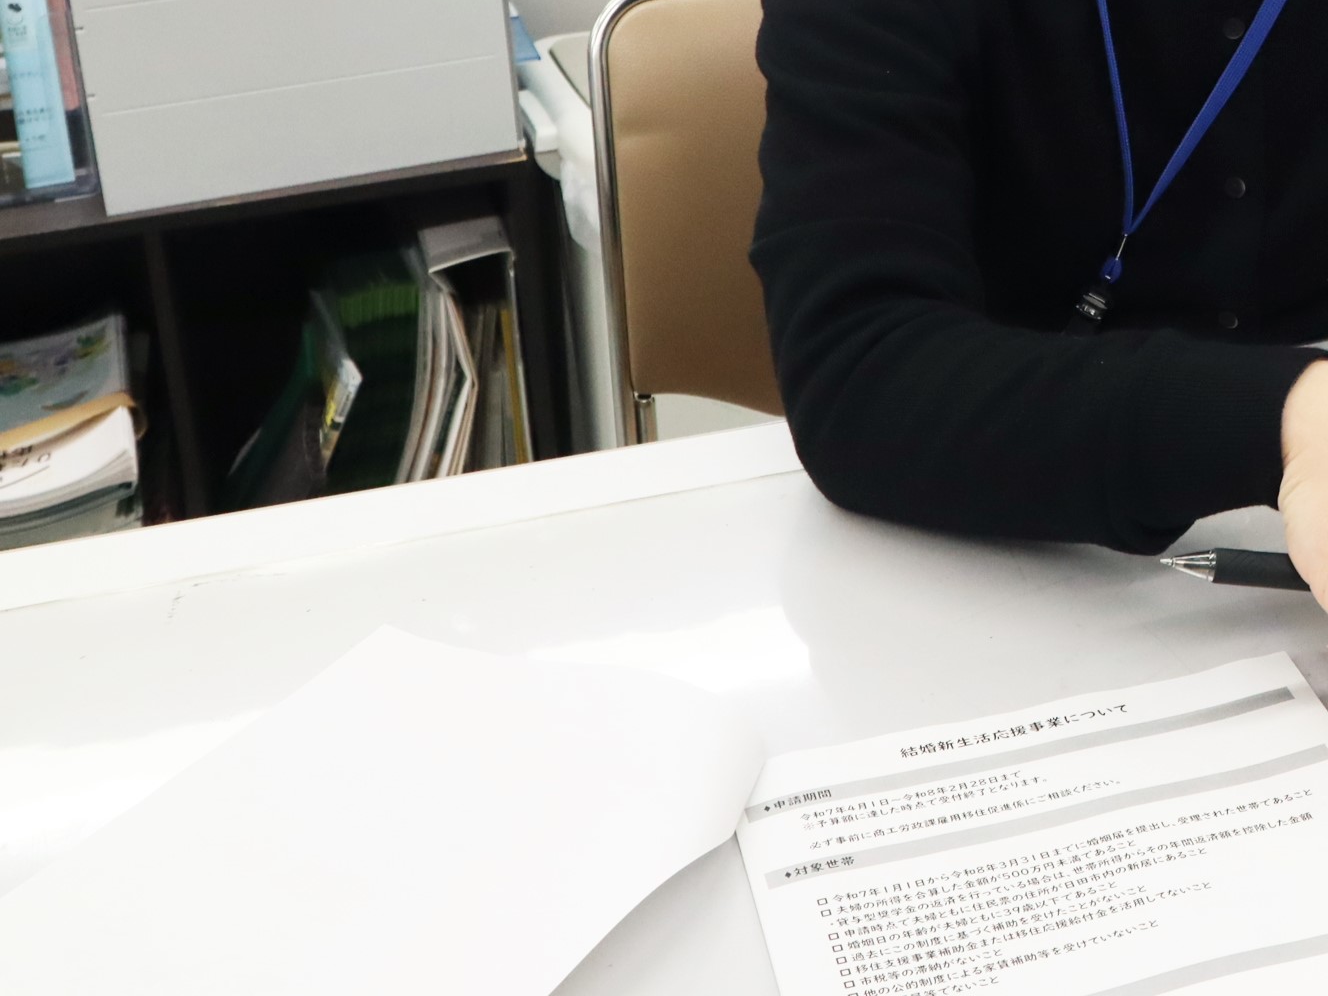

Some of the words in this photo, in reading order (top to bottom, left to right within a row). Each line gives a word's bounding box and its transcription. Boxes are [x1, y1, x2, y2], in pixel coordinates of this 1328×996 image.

[900, 703, 1128, 758] 結婚新生活応援事業について
[773, 789, 833, 810] 申請期間
[809, 777, 1122, 850] 必ず事前に商工労政課雇用移住促進係にご相談ください。
[794, 856, 855, 876] 対象世帯
[836, 838, 1137, 915] 夫婦の所得を合算した金額が500万円未満であること
[843, 846, 1208, 939] 申請時点で夫婦ともに住民票の住所が日田市内の新居にあること
[846, 880, 1118, 951] 婚姻日の年齢が夫婦ともに39歳以下であること
[851, 883, 1147, 963] 過去にこの制度に基づく補助を受けたことがないこと
[855, 880, 1212, 974] 移住支援事業補助金または移住応援給付金を活用してないこと
[860, 948, 1003, 987] 市税等の滞納がないこと
